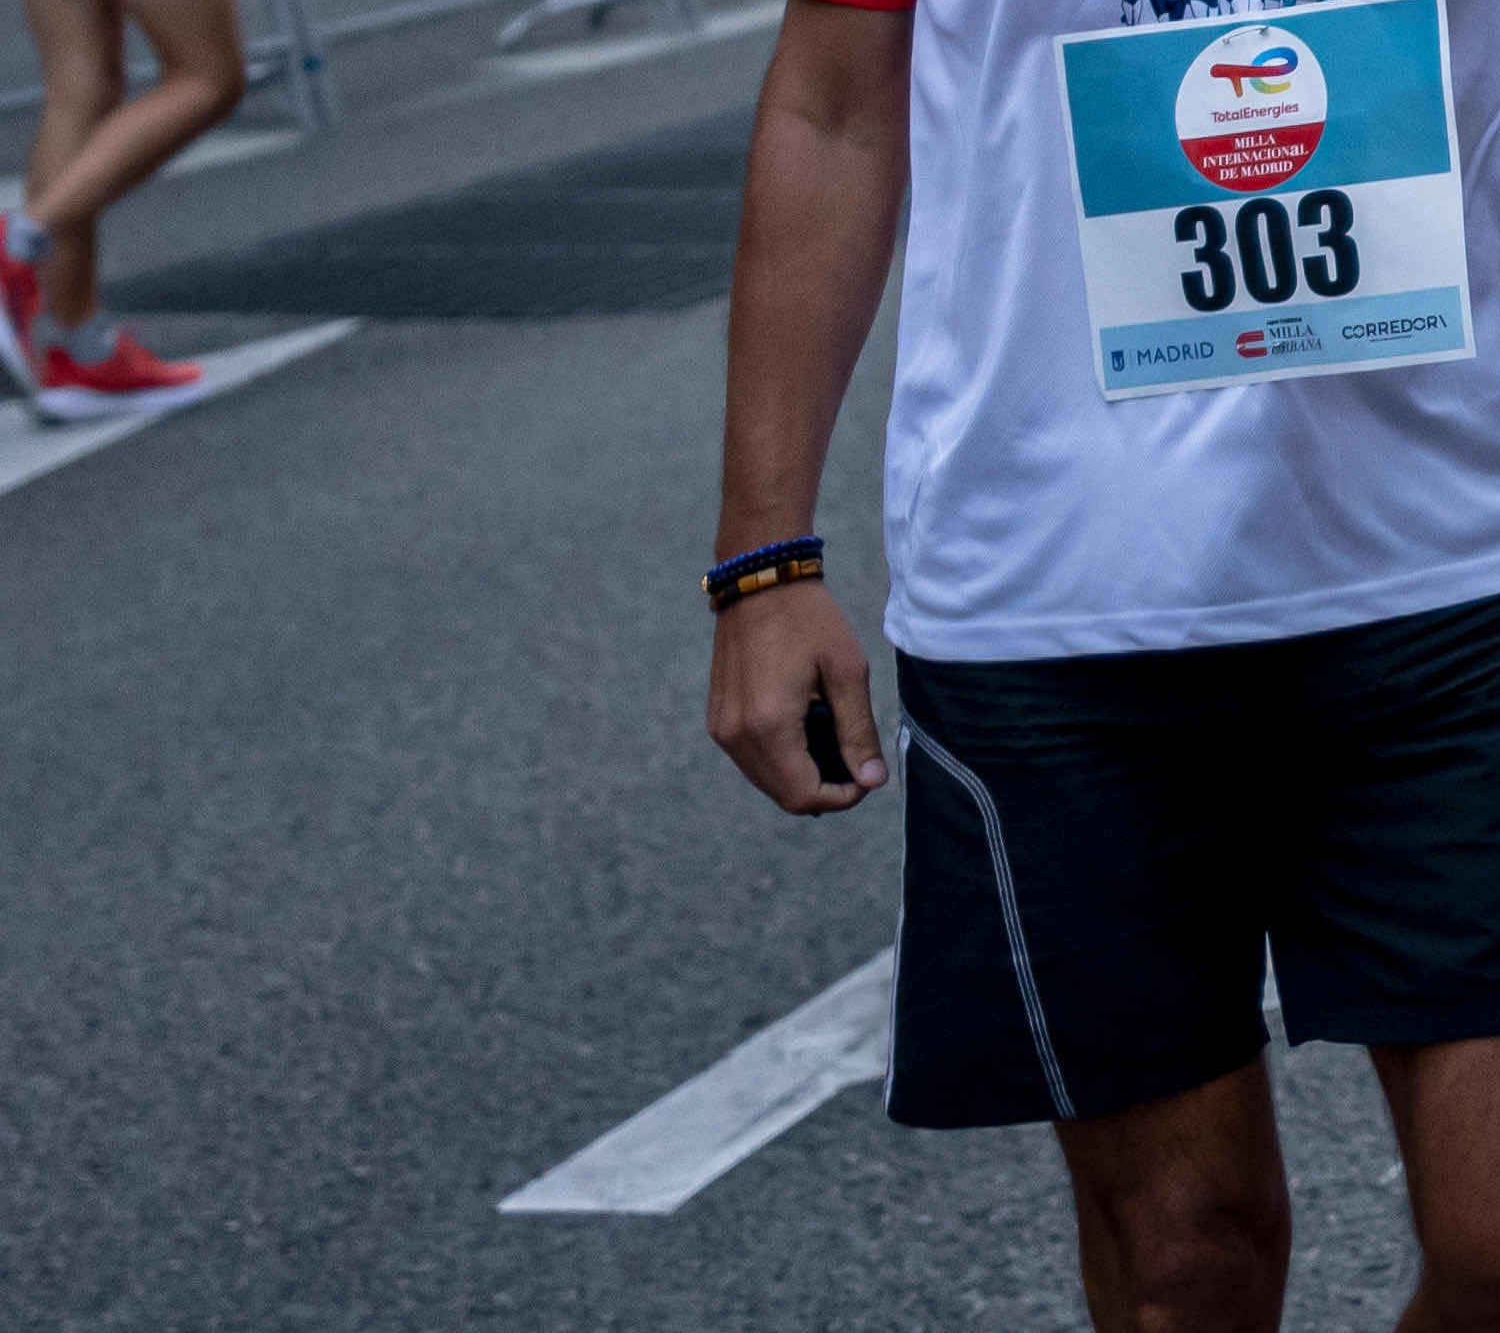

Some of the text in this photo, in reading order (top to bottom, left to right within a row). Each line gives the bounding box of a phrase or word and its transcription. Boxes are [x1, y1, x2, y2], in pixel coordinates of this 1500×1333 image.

[1211, 102, 1299, 123] TotalEnergies
[1234, 133, 1276, 150] MILLA
[1220, 160, 1293, 181] DE MADRID
[1174, 189, 1360, 312] 303
[1268, 324, 1314, 339] MILLA
[1137, 341, 1214, 365] MADRID
